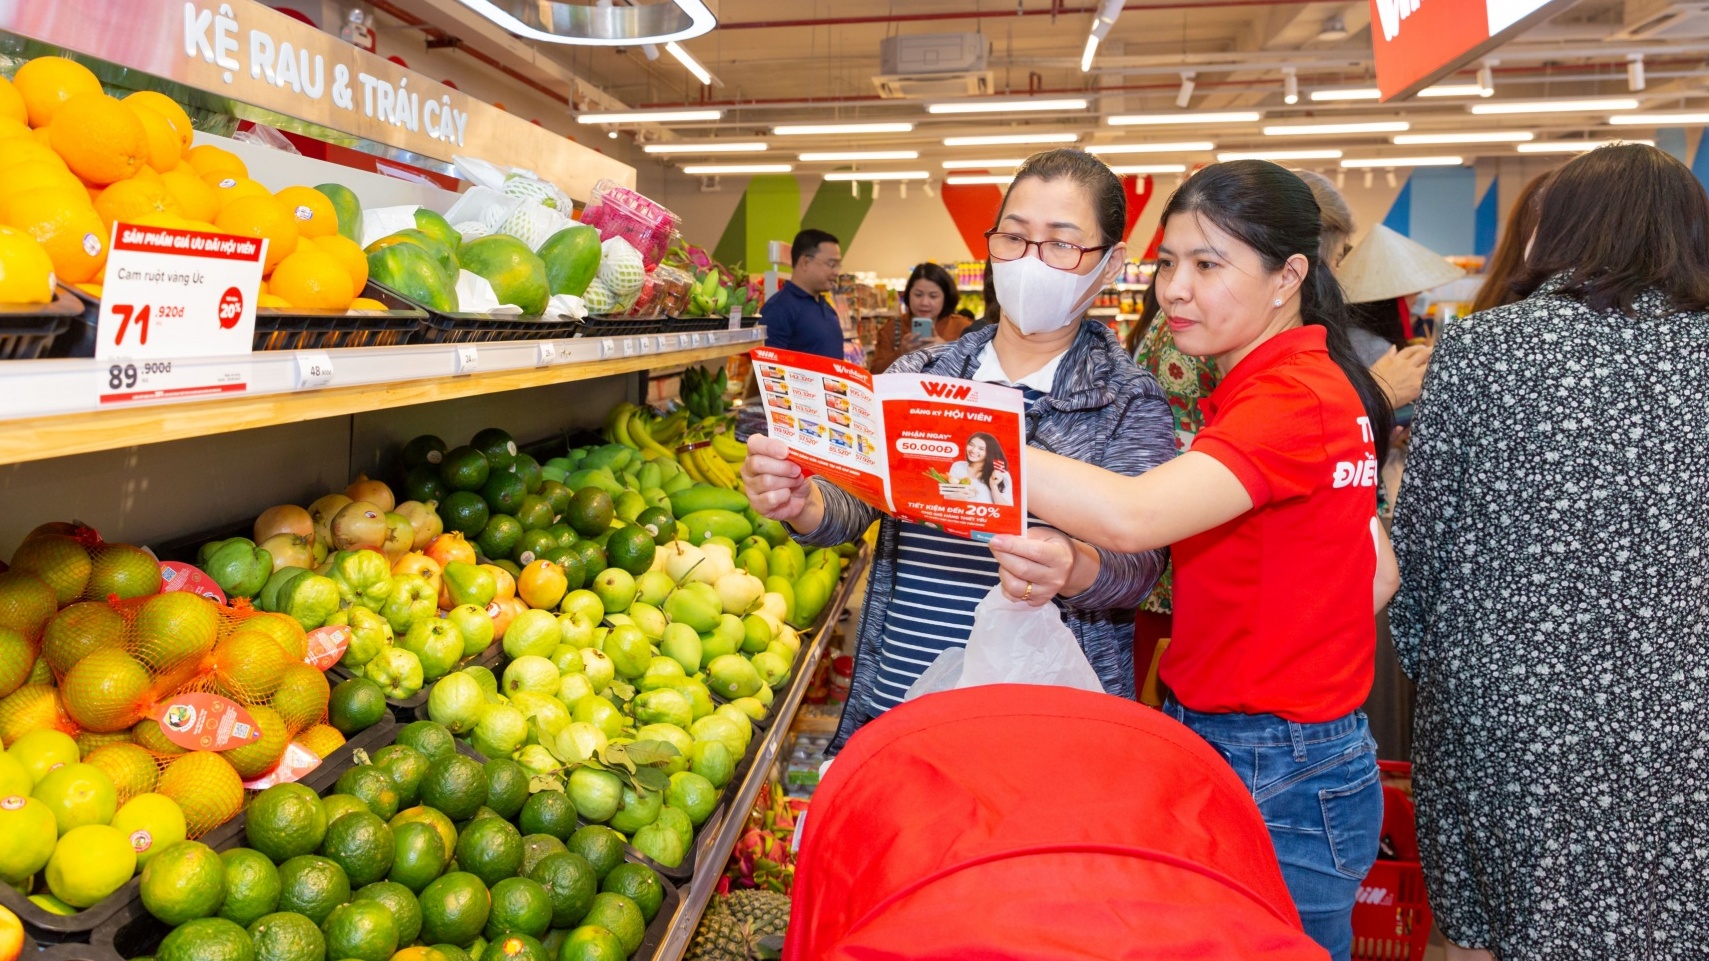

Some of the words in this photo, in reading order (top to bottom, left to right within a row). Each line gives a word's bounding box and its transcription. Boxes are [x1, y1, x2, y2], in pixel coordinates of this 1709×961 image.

[184, 2, 240, 84] KỆ
[250, 29, 325, 100] RAU
[332, 63, 353, 110] &
[359, 72, 419, 133] TRÁI
[423, 94, 468, 147] CÂY
[122, 228, 144, 244] SẢN
[144, 231, 173, 248] PHẨM
[174, 235, 191, 249] GIÁ
[191, 237, 203, 250] ƯU
[204, 237, 220, 252] ĐÃI
[220, 240, 236, 256] HỘI
[236, 241, 256, 255] VIÊN
[118, 268, 141, 281] Cam
[144, 270, 165, 284] ruột
[168, 270, 189, 286] vàng
[192, 269, 204, 284] Úc
[220, 303, 241, 319] 20%
[112, 305, 150, 346] 71
[109, 364, 137, 390] 89
[310, 365, 321, 377] 48
[944, 409, 964, 419] HỘI
[966, 411, 992, 423] VIÊN
[901, 430, 925, 439] NHẬN
[1356, 416, 1374, 443] T
[902, 442, 953, 453] 50.000Đ
[1332, 452, 1378, 489] ĐIỀ
[908, 501, 925, 509] TIẾT
[925, 503, 945, 513] KIỆM
[947, 505, 964, 514] ĐẾN
[965, 505, 1000, 518] 20%
